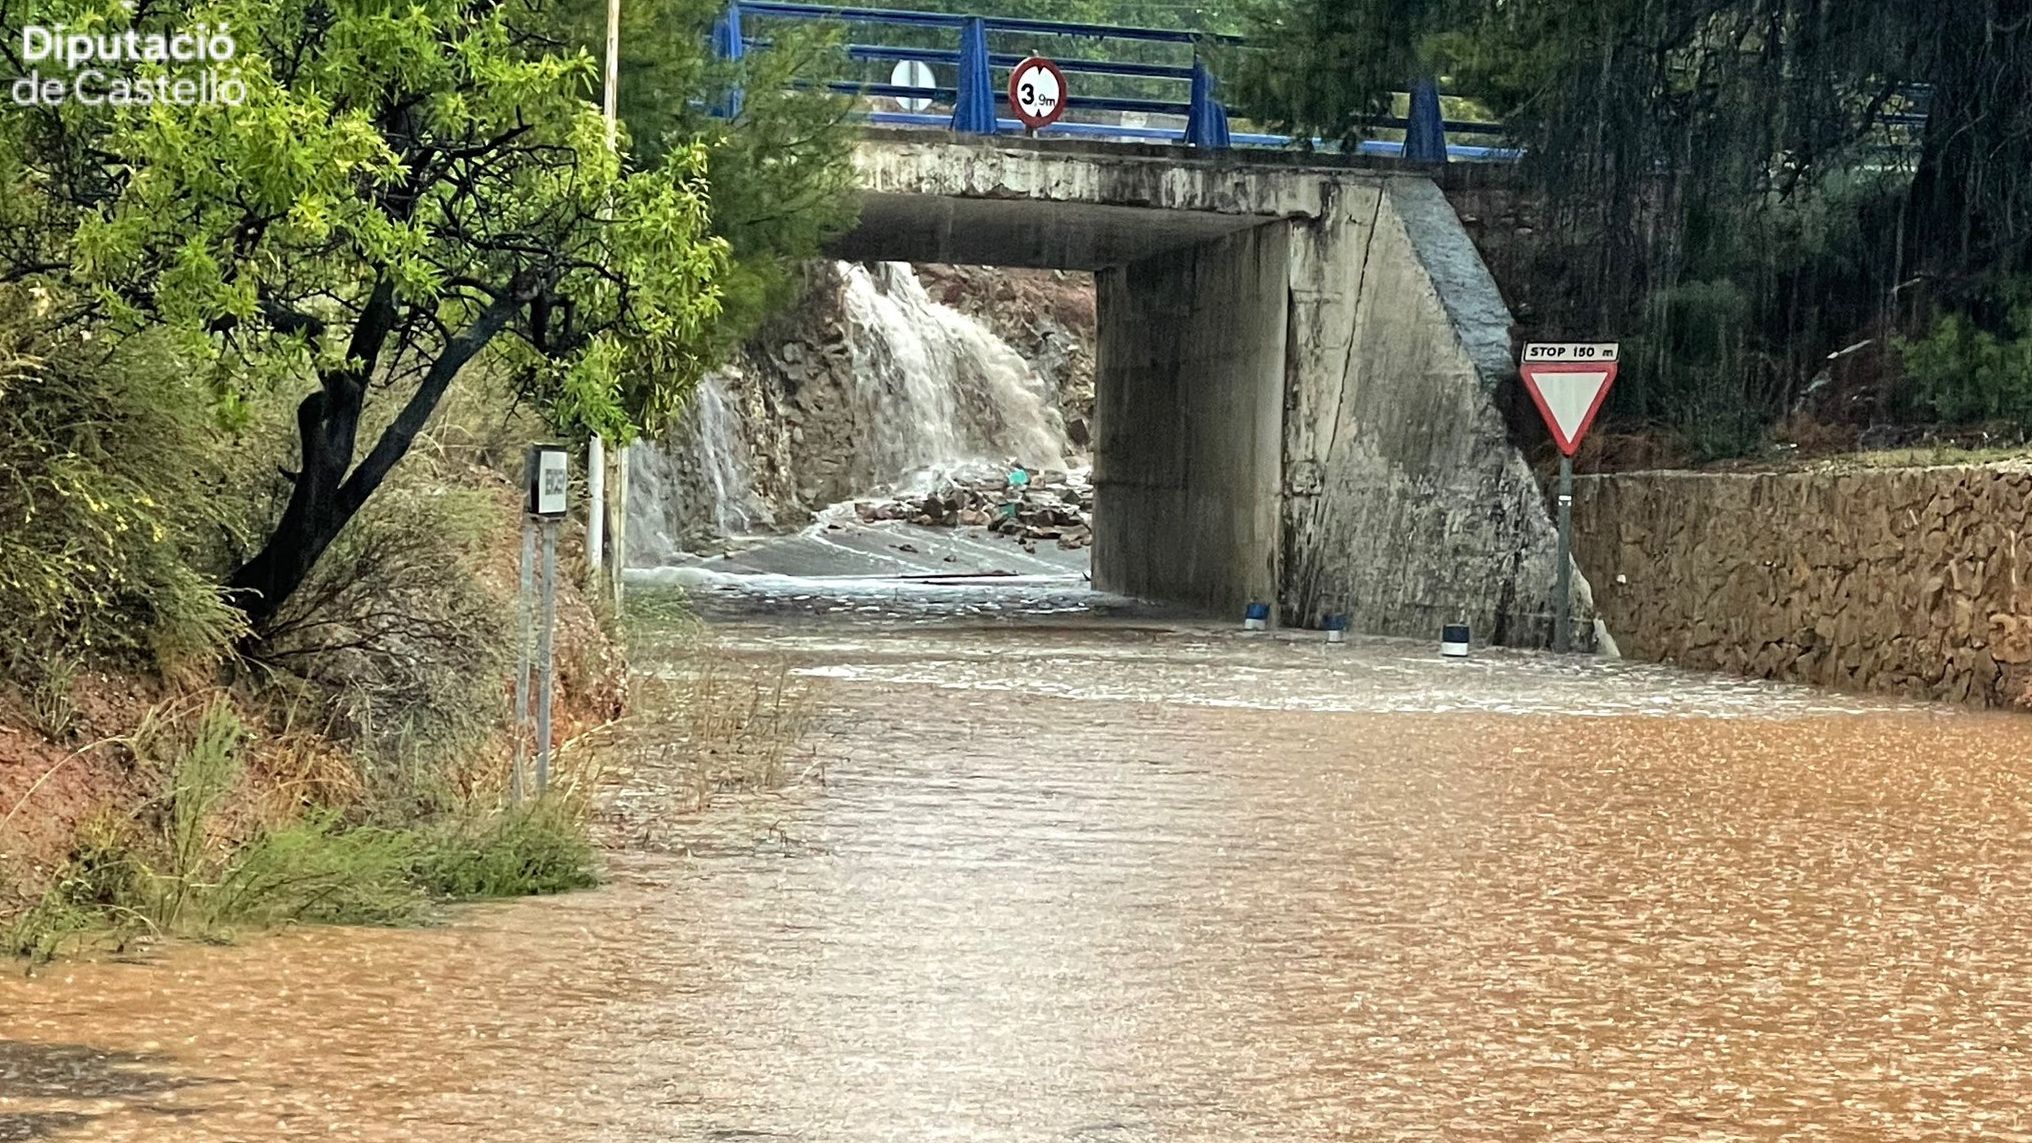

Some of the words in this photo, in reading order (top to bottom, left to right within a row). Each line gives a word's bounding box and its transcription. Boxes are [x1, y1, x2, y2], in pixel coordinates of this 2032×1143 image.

[1530, 347, 1566, 357] STOP
[1573, 346, 1595, 357] 150
[1602, 349, 1613, 357] m
